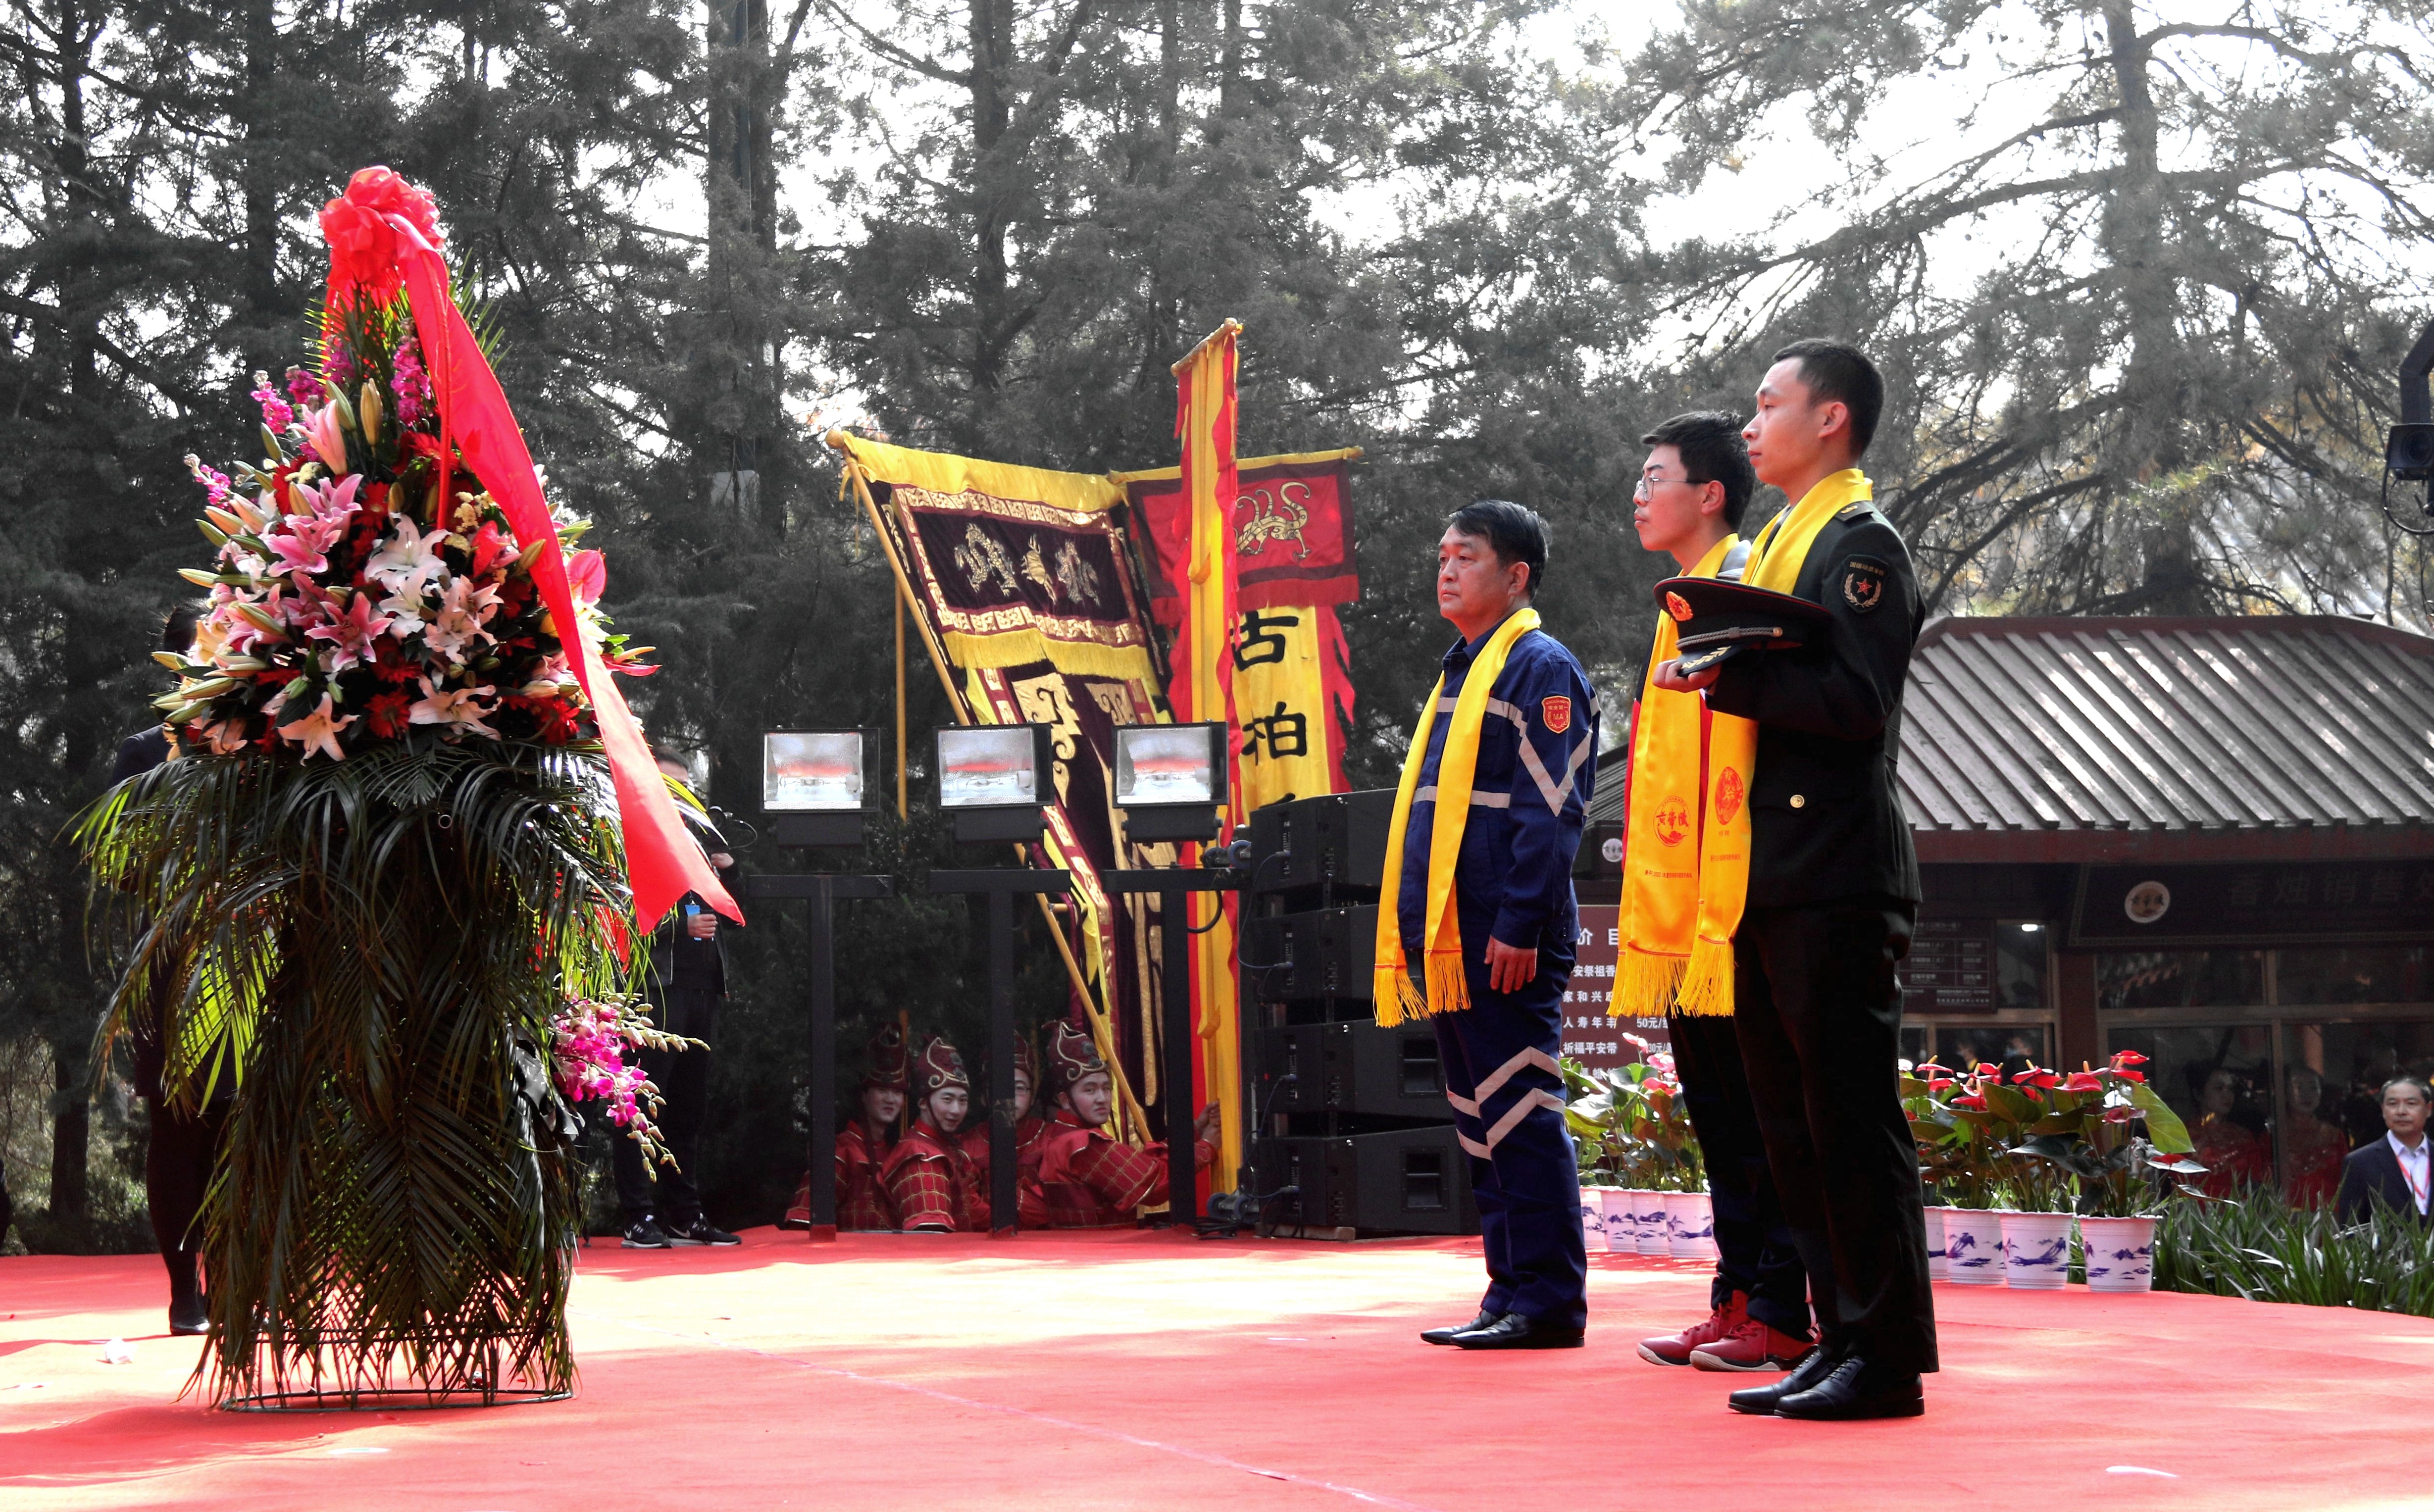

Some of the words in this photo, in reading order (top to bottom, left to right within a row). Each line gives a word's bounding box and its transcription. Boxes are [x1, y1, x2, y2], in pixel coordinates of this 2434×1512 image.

[1563, 1016, 1616, 1029] 人寿年丰
[1563, 1042, 1617, 1054] 祈福平安带
